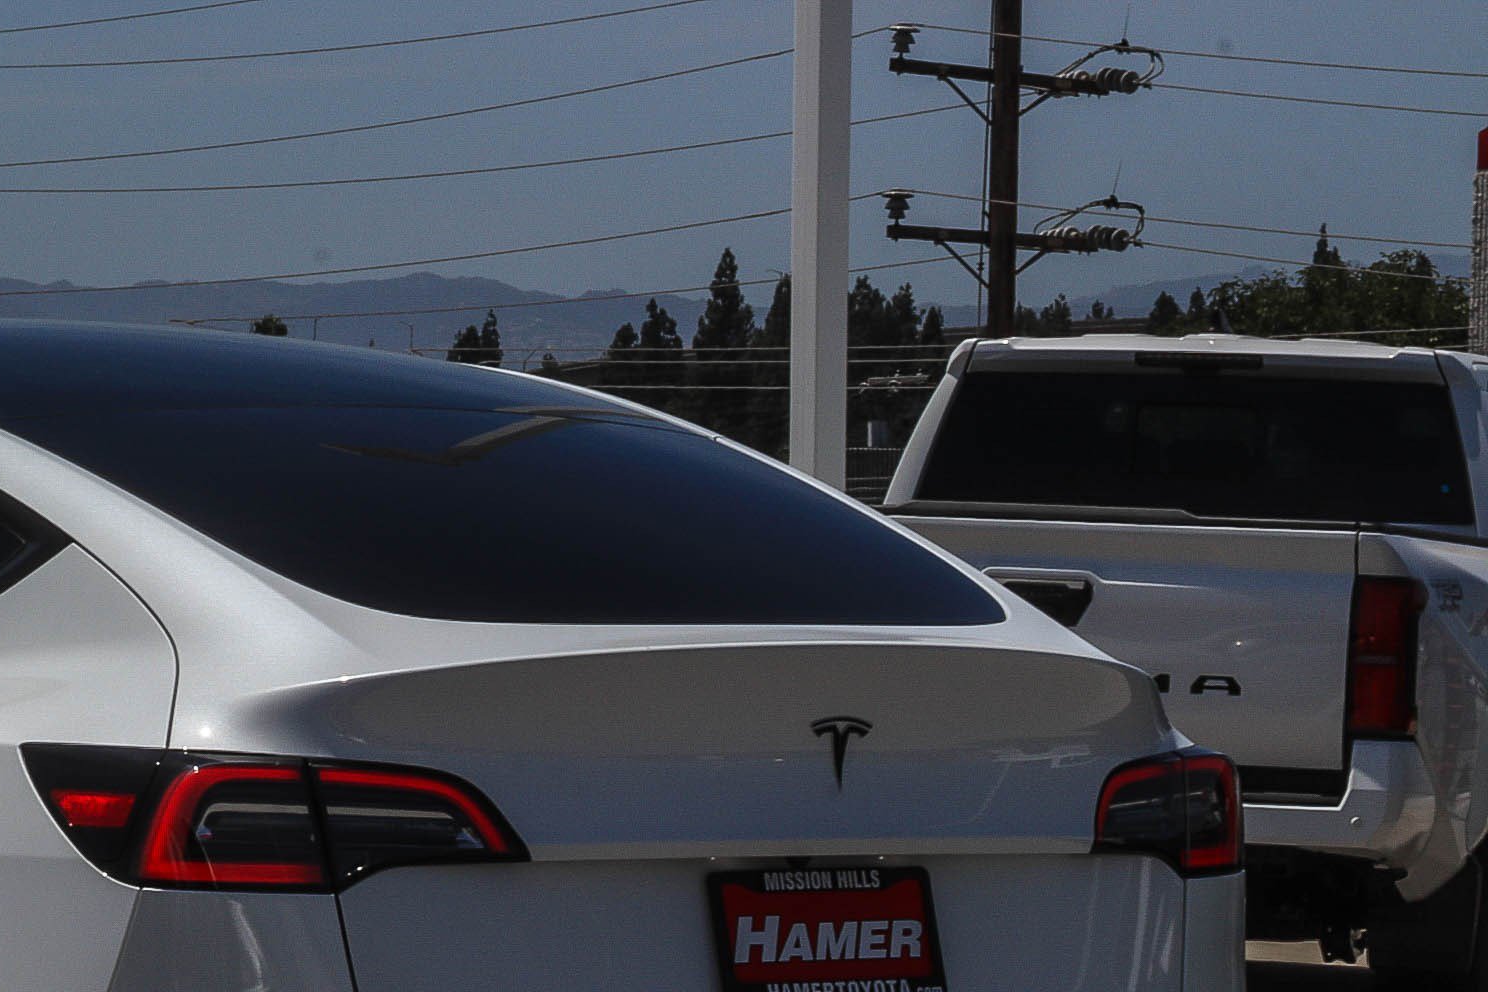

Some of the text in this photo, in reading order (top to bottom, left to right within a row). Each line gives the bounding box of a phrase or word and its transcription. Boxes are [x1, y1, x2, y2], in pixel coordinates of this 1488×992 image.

[763, 869, 881, 892] MISSION HILLS
[734, 914, 923, 964] HAMER
